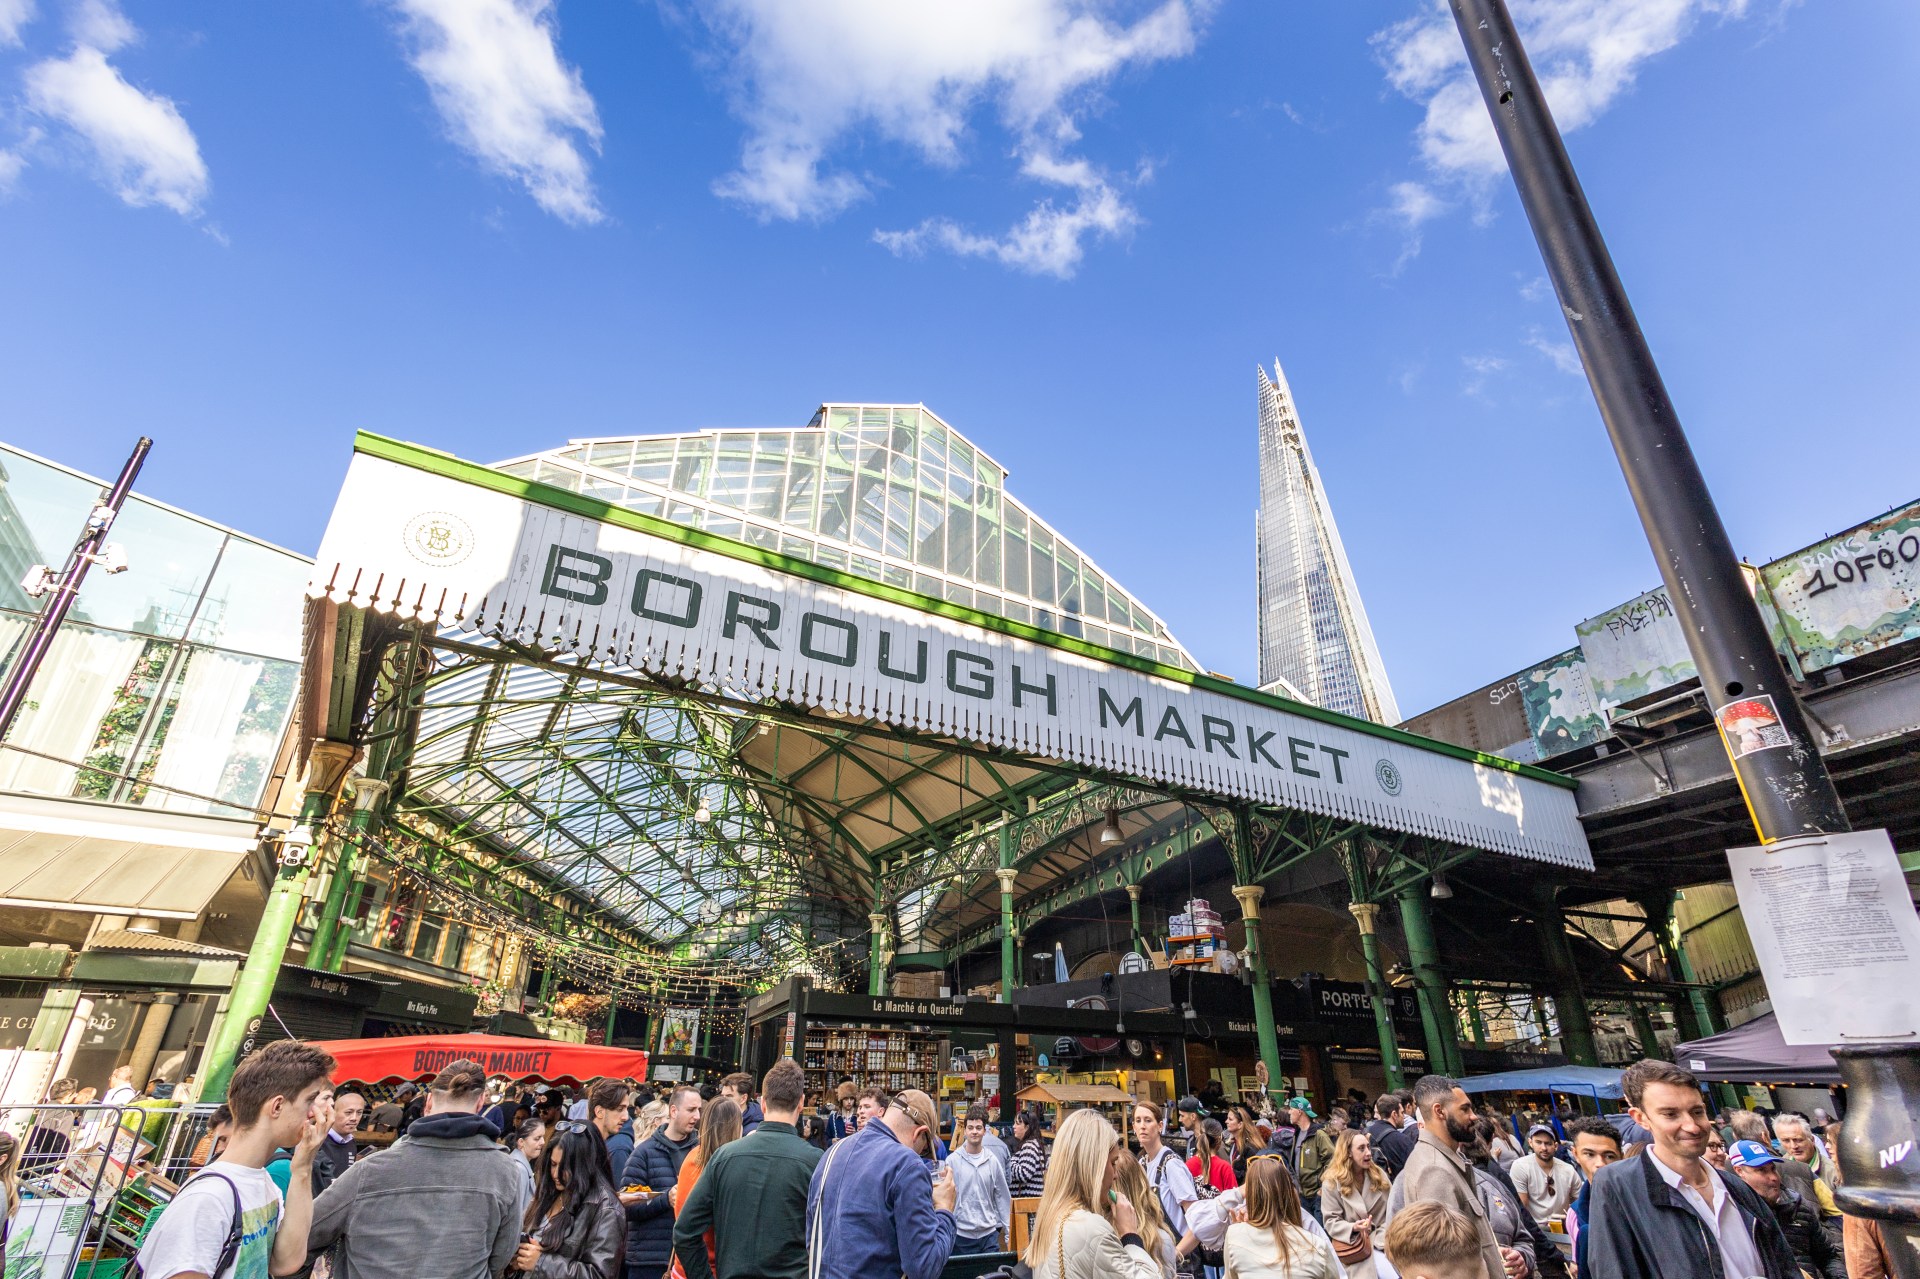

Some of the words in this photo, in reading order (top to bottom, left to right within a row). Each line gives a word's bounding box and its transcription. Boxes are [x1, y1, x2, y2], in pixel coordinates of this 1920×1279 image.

[540, 543, 1057, 716] BOROUGH
[1099, 687, 1350, 784] MARKET
[1489, 676, 1529, 705] SIDE
[310, 976, 321, 988] The
[322, 979, 340, 993] Ginger
[339, 981, 350, 996] Pig
[406, 1000, 416, 1012] Mrs
[416, 1002, 430, 1014] King's
[429, 1004, 438, 1016] Pies
[873, 1000, 882, 1011] Le
[885, 1000, 915, 1013] Marché
[917, 1002, 928, 1014] du
[930, 1004, 963, 1016] Quartier
[87, 1017, 117, 1030] PIG
[1228, 1021, 1250, 1032] Richard
[1276, 1024, 1294, 1035] Oyster
[488, 1052, 552, 1073] MARKET
[1879, 1140, 1912, 1169] NV
[57, 1206, 77, 1233] MARKET
[67, 1206, 86, 1237] BOROUGH
